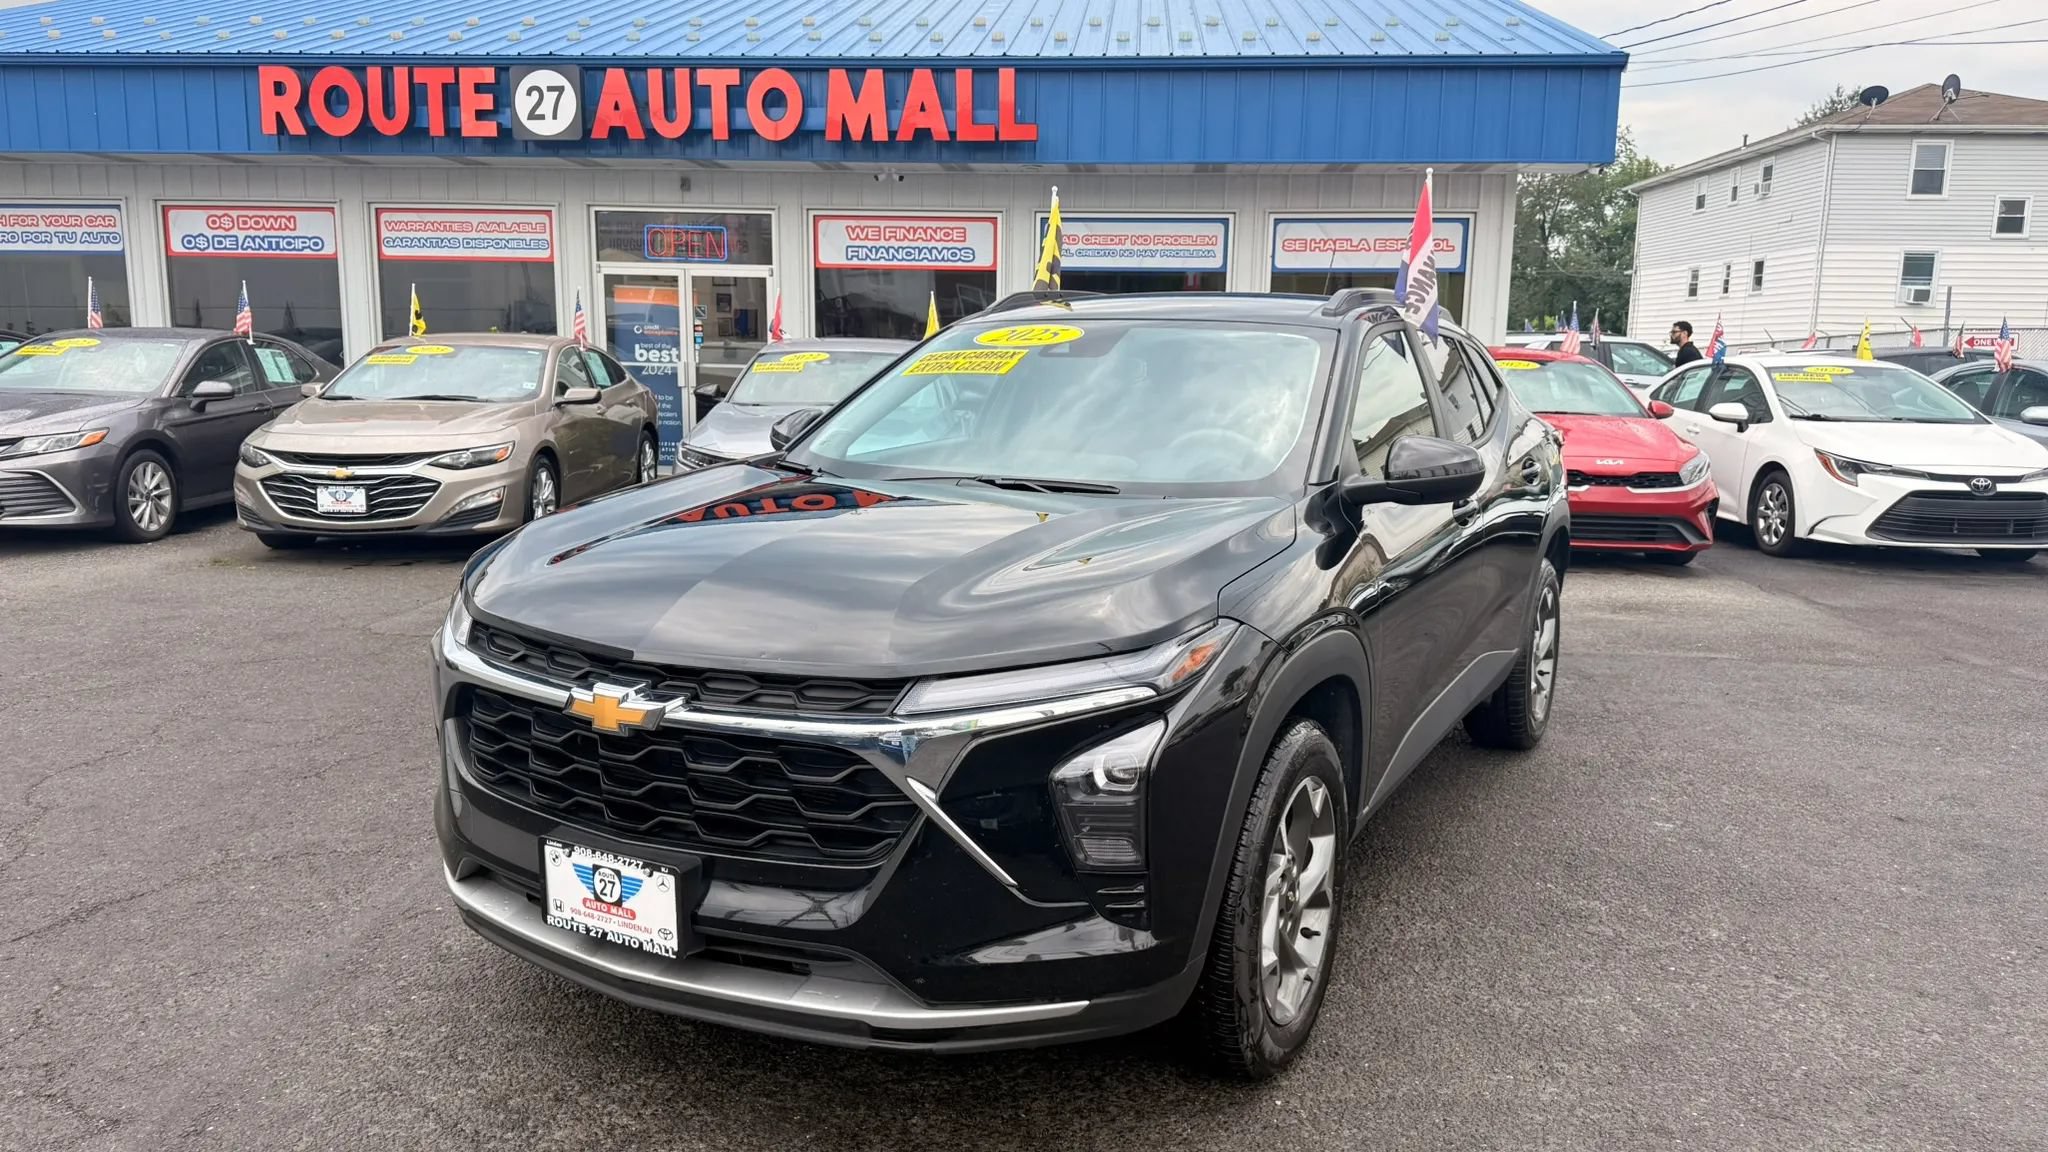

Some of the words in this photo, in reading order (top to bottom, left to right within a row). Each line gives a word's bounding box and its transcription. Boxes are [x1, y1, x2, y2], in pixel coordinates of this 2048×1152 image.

[258, 65, 498, 138] ROUTE
[526, 85, 565, 121] 27
[590, 67, 803, 141] AUTO
[825, 68, 1038, 142] MALL
[9, 215, 38, 227] FOR
[42, 215, 82, 227] YOUR
[85, 216, 116, 228] CAR
[237, 214, 297, 231] DOWN
[384, 220, 473, 233] WARRANTIES
[475, 221, 546, 234] AVAILABLE
[22, 231, 52, 244] POR
[54, 232, 77, 244] TU
[80, 232, 121, 244] AUTO
[846, 225, 881, 241] WE
[883, 226, 966, 243] FINANCE
[1082, 234, 1129, 246] CREDIT
[1131, 235, 1152, 246] NO
[1153, 235, 1218, 247] PROBLEM
[212, 234, 239, 250] DE
[240, 235, 324, 252] ANTICIPO
[383, 236, 460, 248] GARANTIAS
[462, 237, 549, 250] DISPONIBLES
[648, 227, 724, 260] OPEN
[1282, 238, 1306, 252] SE
[1309, 238, 1370, 252] HABLA
[1373, 239, 1455, 253] ESPOL
[846, 245, 975, 263] FINANCIAMOS
[1075, 249, 1117, 258] CREDITO
[1119, 249, 1135, 258] NO
[1136, 249, 1159, 258] HAY
[1159, 249, 1217, 258] PROBLEMA
[987, 328, 1070, 342] 2025
[1974, 338, 1992, 346] ONE
[634, 343, 679, 362] best
[919, 351, 963, 362] CLEAN
[962, 350, 1021, 360] CARFAX
[641, 365, 672, 375] 2024
[909, 361, 954, 373] EXTRA
[955, 361, 1008, 373] CLEAN
[573, 845, 644, 870] 908-648-2727
[598, 870, 616, 880] ROUTE
[599, 878, 616, 898] 27
[569, 907, 613, 924] 908-648-2727
[585, 900, 608, 912] AUTO
[610, 905, 633, 919] MALL
[546, 914, 587, 934] ROUTE
[589, 926, 604, 939] 27
[606, 931, 640, 949] AUTO
[642, 940, 677, 959] MALL
